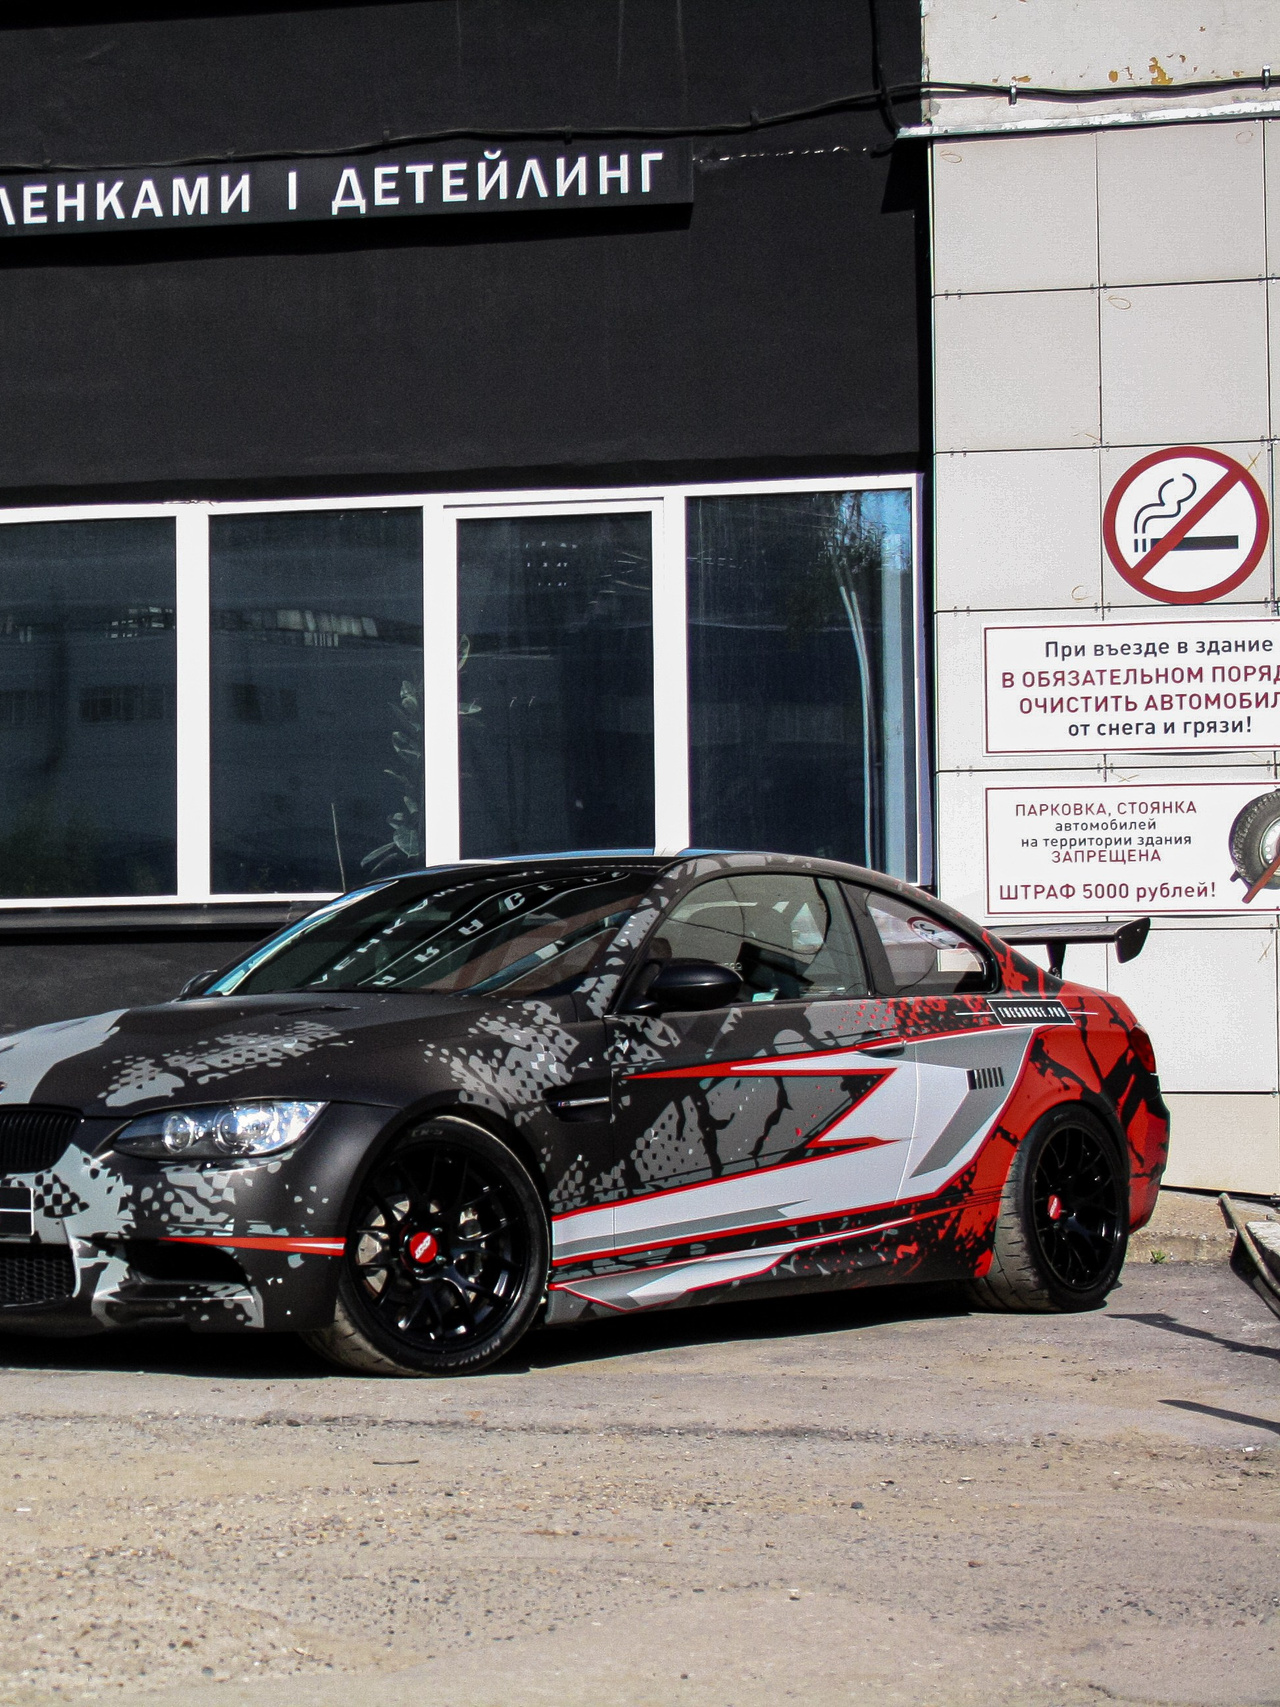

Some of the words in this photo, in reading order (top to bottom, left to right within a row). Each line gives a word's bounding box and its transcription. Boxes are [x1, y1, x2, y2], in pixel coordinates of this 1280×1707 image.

[331, 149, 663, 216] ДЕТЕЙЛИНГ
[1046, 641, 1086, 661] При
[1094, 640, 1170, 658] въезде
[1178, 641, 1188, 653] в
[1196, 639, 1274, 656] здание
[1002, 672, 1015, 688] В
[1022, 666, 1203, 688] ОБЯЗАТЕЛЬНОМ
[1019, 695, 1138, 714] ОЧИСТИТЬ
[1068, 723, 1090, 737] от
[1097, 721, 1156, 736] снега
[1163, 722, 1175, 735] и
[1183, 716, 1251, 738] грязи!
[1015, 803, 1111, 818] ПАРКОВКА,
[1117, 801, 1197, 815] СТОЯНКА
[1055, 818, 1156, 831] автомобилей
[1021, 838, 1038, 848] на
[1043, 837, 1132, 850] территории
[1137, 835, 1192, 848] здания
[1051, 849, 1161, 865] ЗАПРЕЩЕНА
[999, 883, 1076, 901] ШТРАФ
[1082, 883, 1129, 899] 5000
[1136, 881, 1216, 902] рублей!
